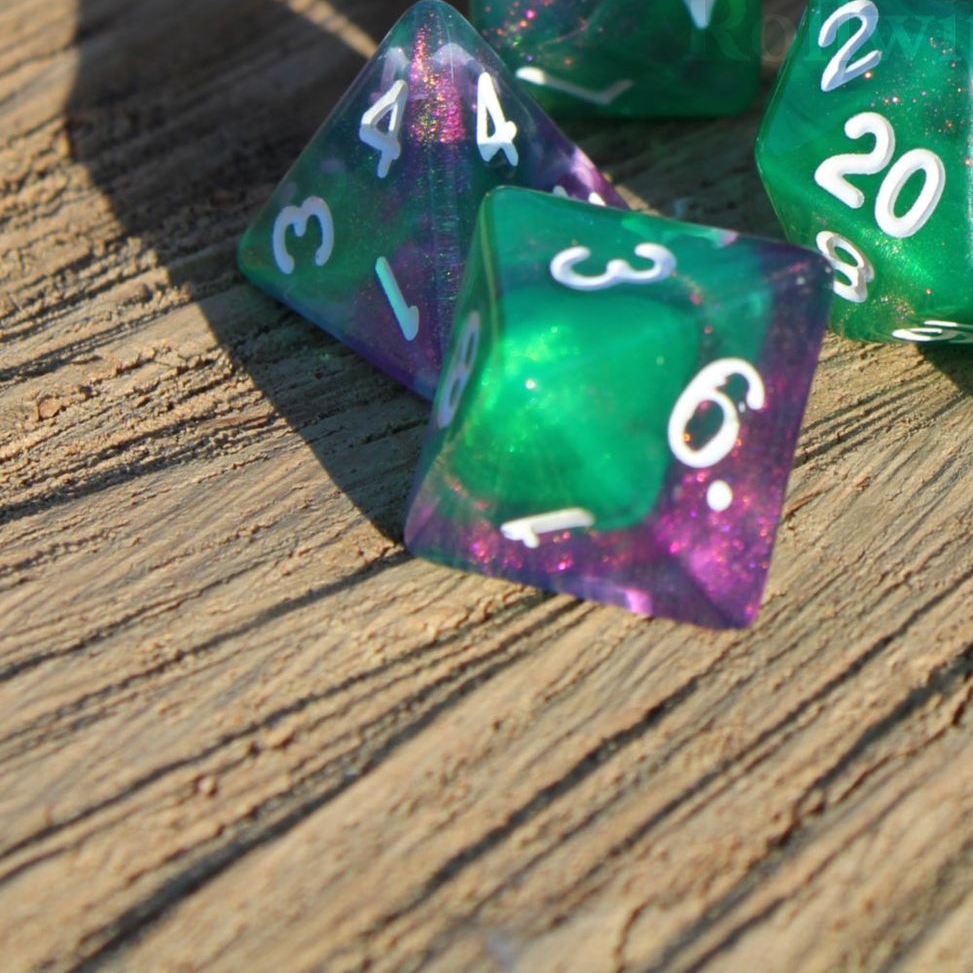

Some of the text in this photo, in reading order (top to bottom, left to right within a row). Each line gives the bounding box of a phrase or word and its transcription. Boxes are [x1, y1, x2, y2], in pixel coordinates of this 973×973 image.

[359, 79, 408, 178] 4
[477, 72, 518, 166] 4
[814, 112, 946, 238] 20
[273, 196, 334, 274] 3
[550, 242, 677, 291] 3
[816, 230, 874, 303] 8
[375, 256, 419, 341] 1
[501, 507, 595, 548] 1
